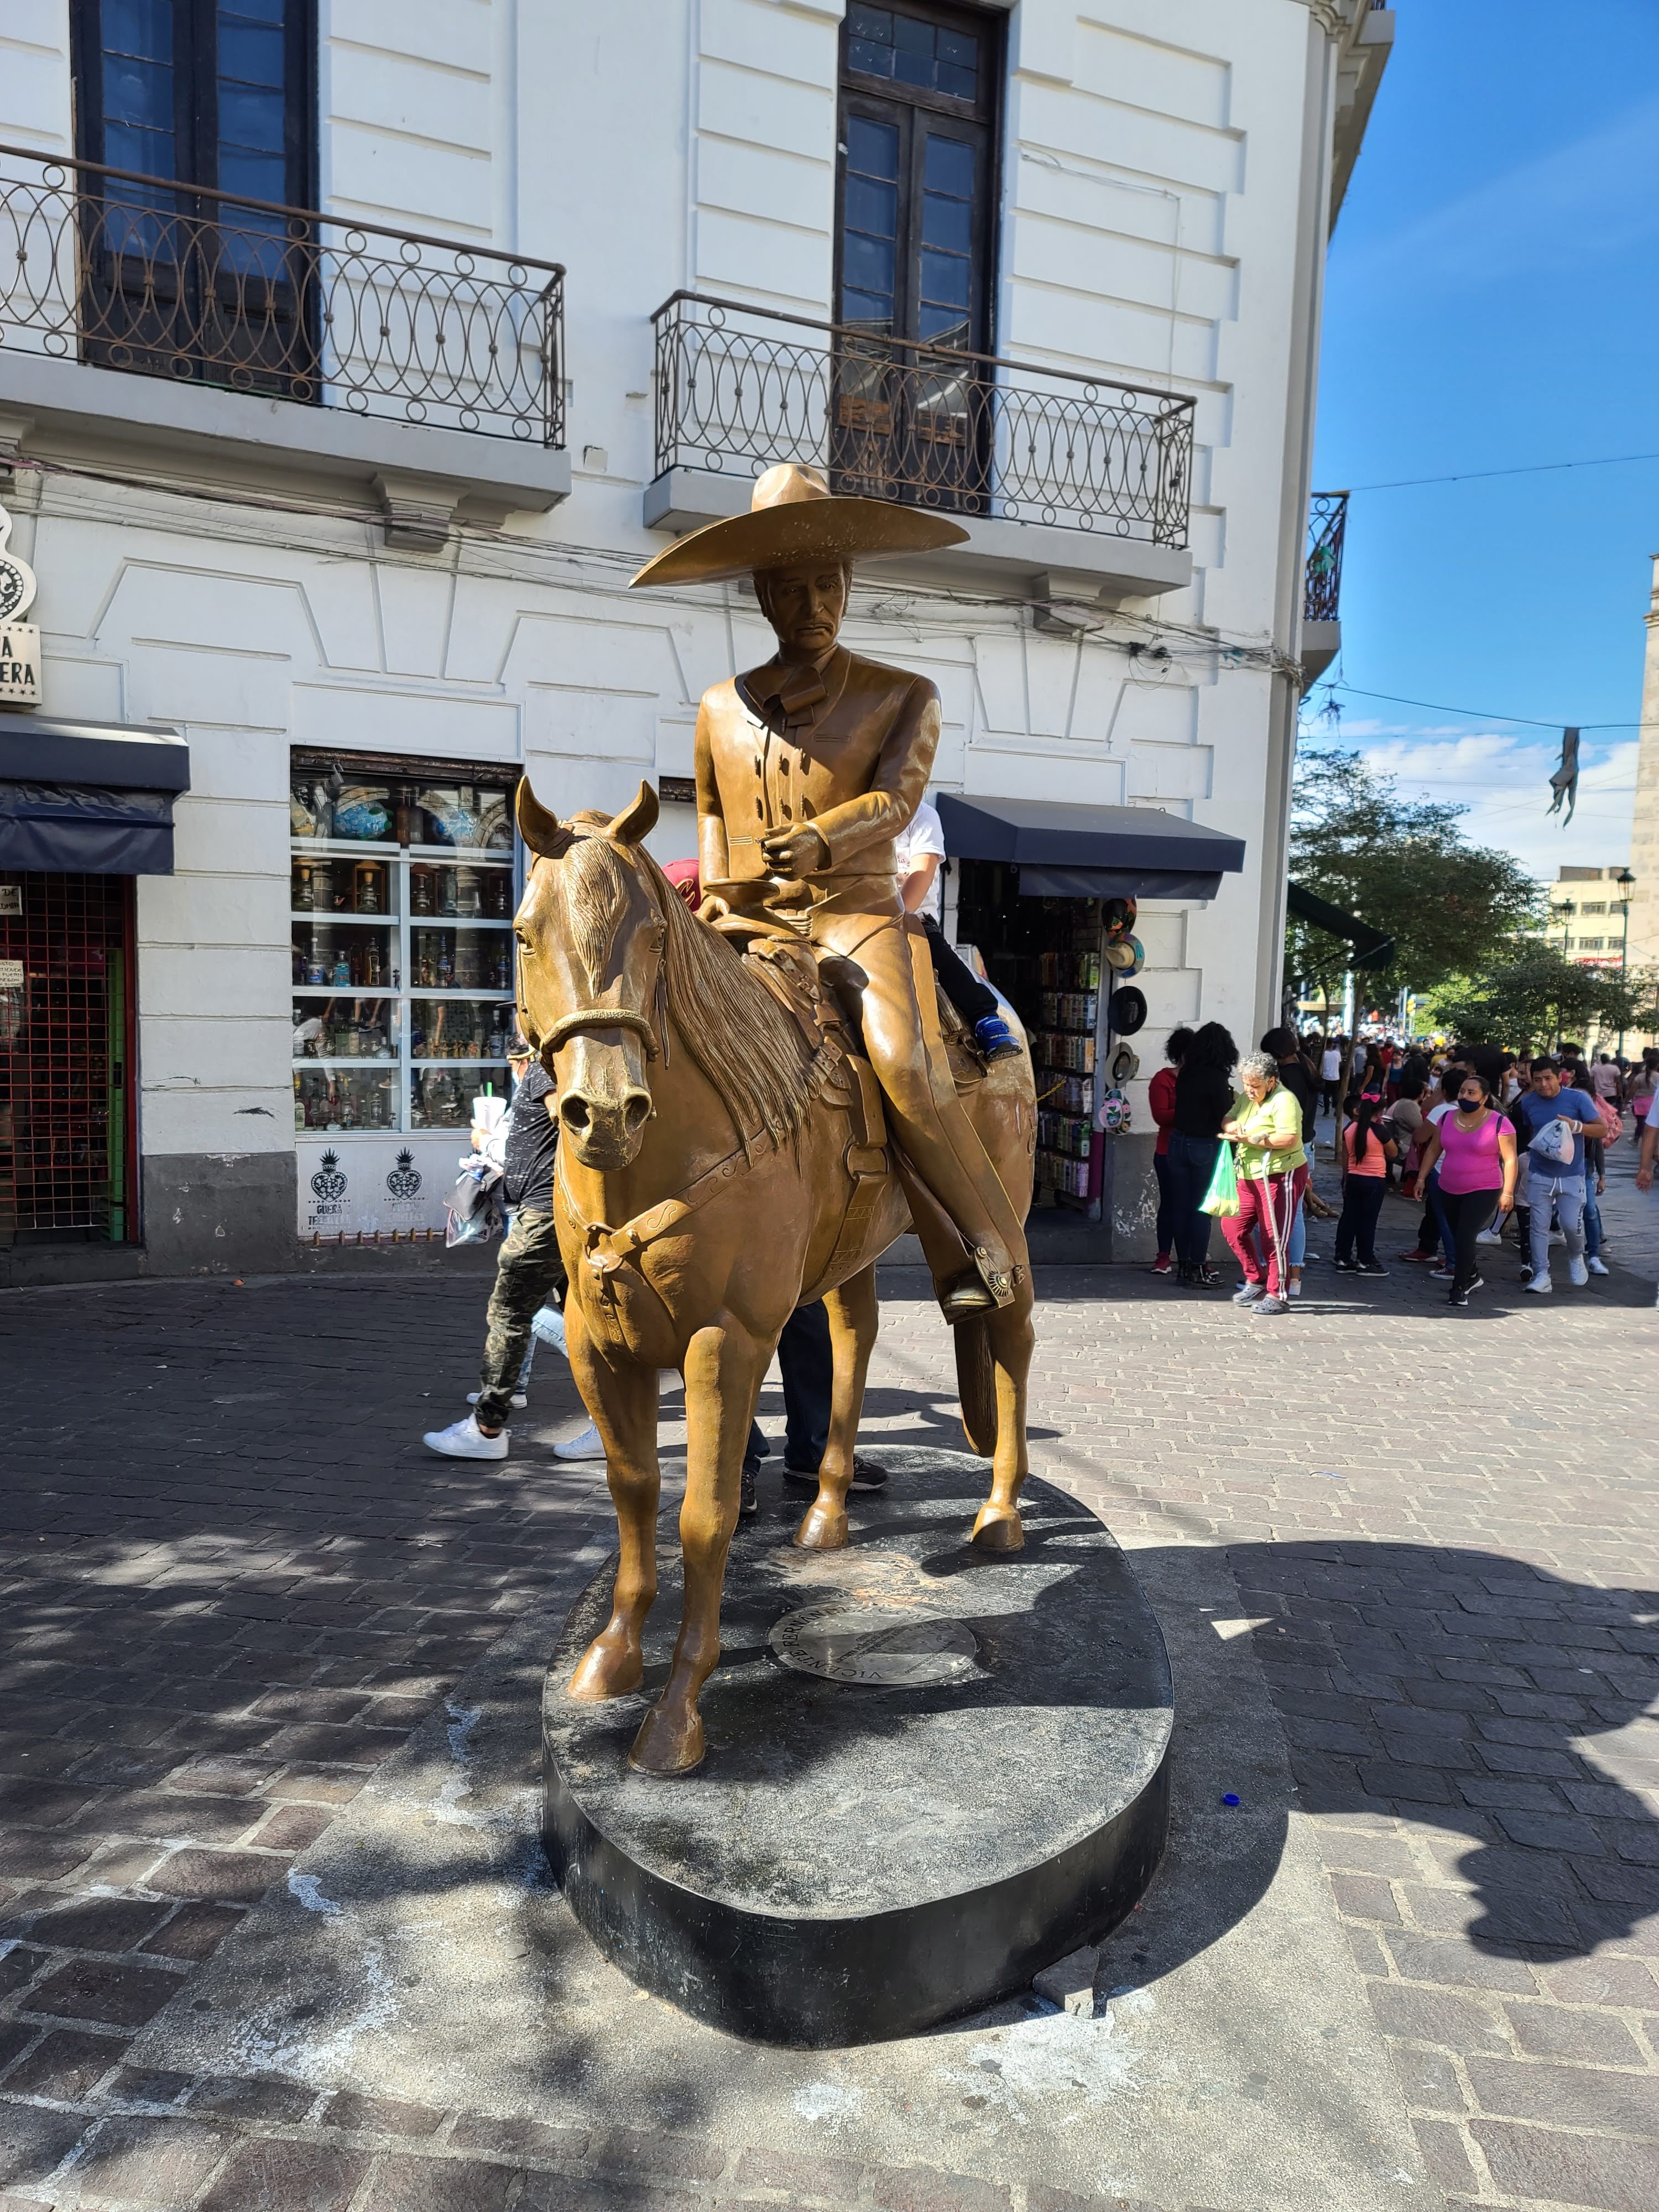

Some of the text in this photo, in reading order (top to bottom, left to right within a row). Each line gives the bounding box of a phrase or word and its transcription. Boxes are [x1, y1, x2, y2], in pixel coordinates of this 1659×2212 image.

[0, 636, 13, 658] A
[782, 1606, 865, 1647] FERNÁNDEZ
[789, 1648, 884, 1679] VICENTE
